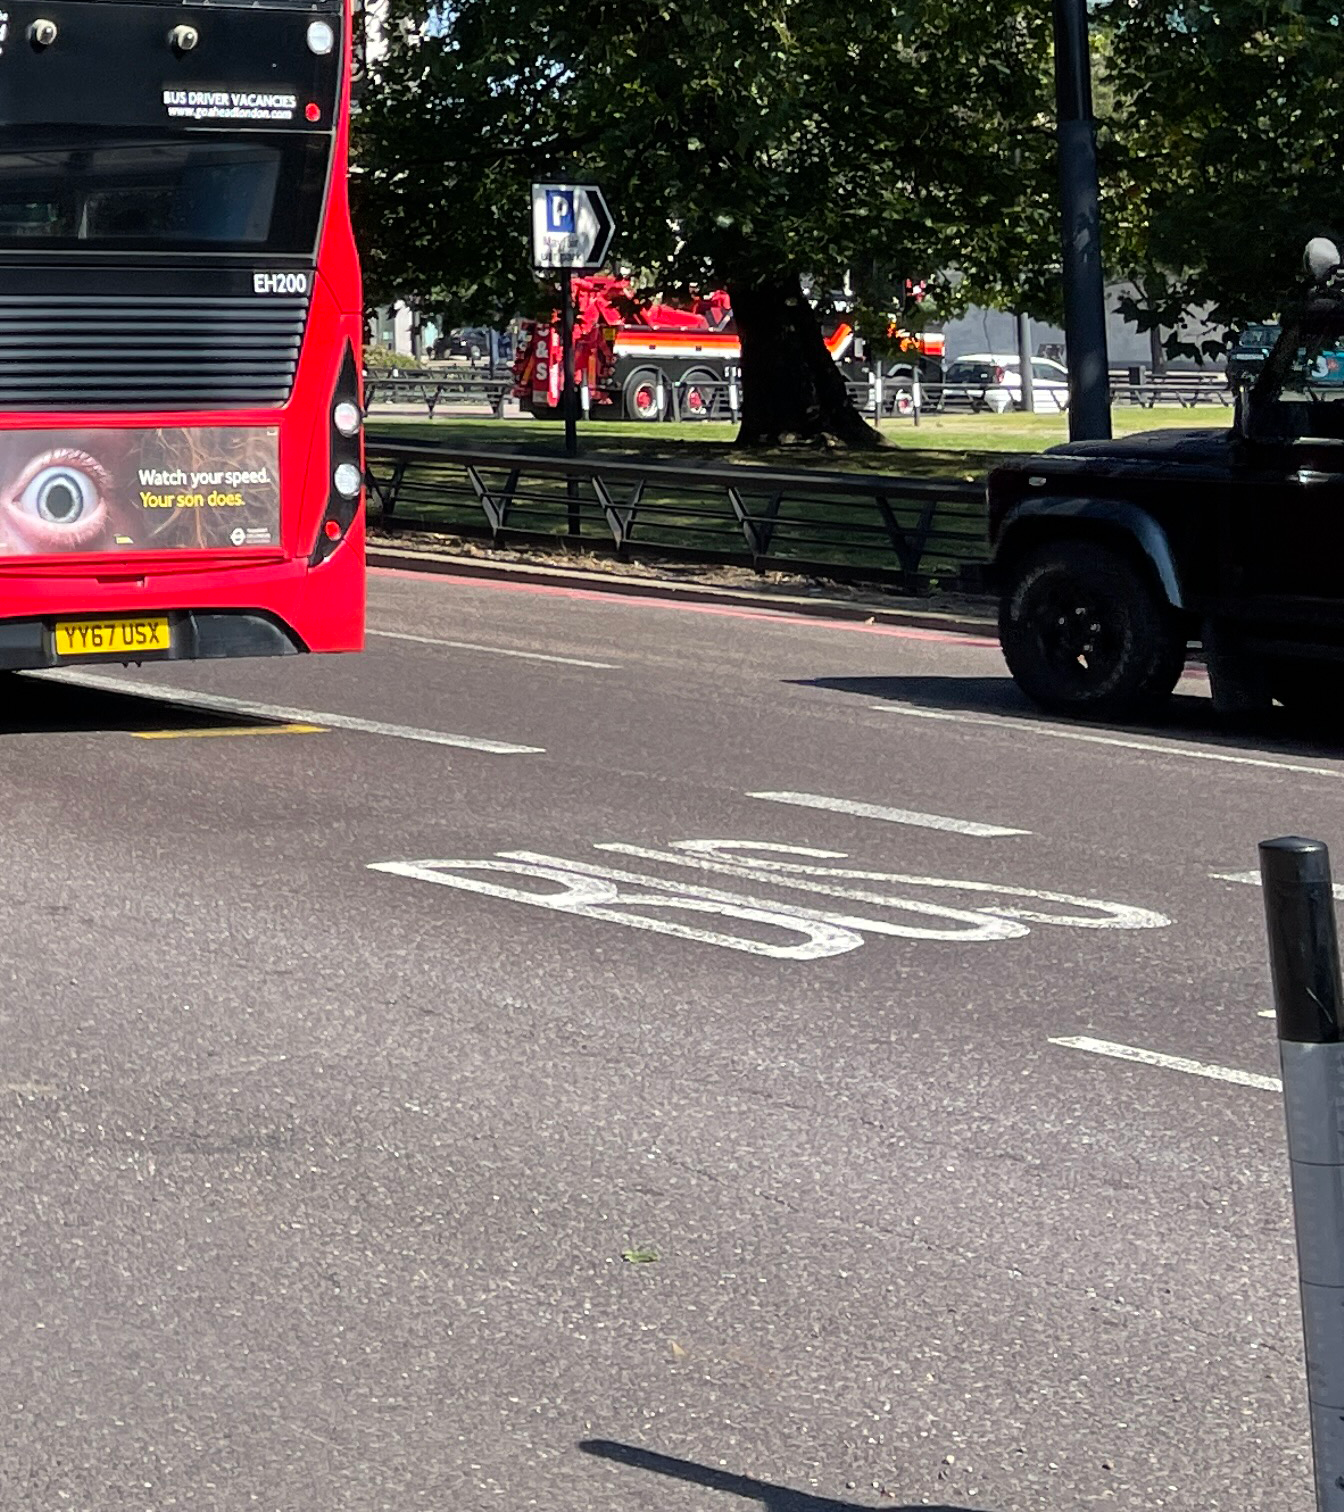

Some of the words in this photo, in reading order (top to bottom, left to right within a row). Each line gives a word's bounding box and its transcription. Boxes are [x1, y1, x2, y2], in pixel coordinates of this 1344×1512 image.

[163, 91, 187, 105] BUS
[188, 92, 230, 106] DRIVER
[231, 93, 296, 108] VACANCIES
[552, 196, 569, 227] P
[254, 273, 307, 293] EH200
[535, 341, 549, 359] &
[535, 362, 548, 381] S
[138, 469, 187, 486] Watch
[190, 471, 224, 489] your
[224, 467, 272, 488] speed.
[139, 491, 175, 508] Your
[176, 493, 204, 507] son
[207, 490, 246, 507] does.
[64, 624, 116, 649] YY67
[121, 621, 160, 646] USX
[366, 838, 1176, 961] BUS
